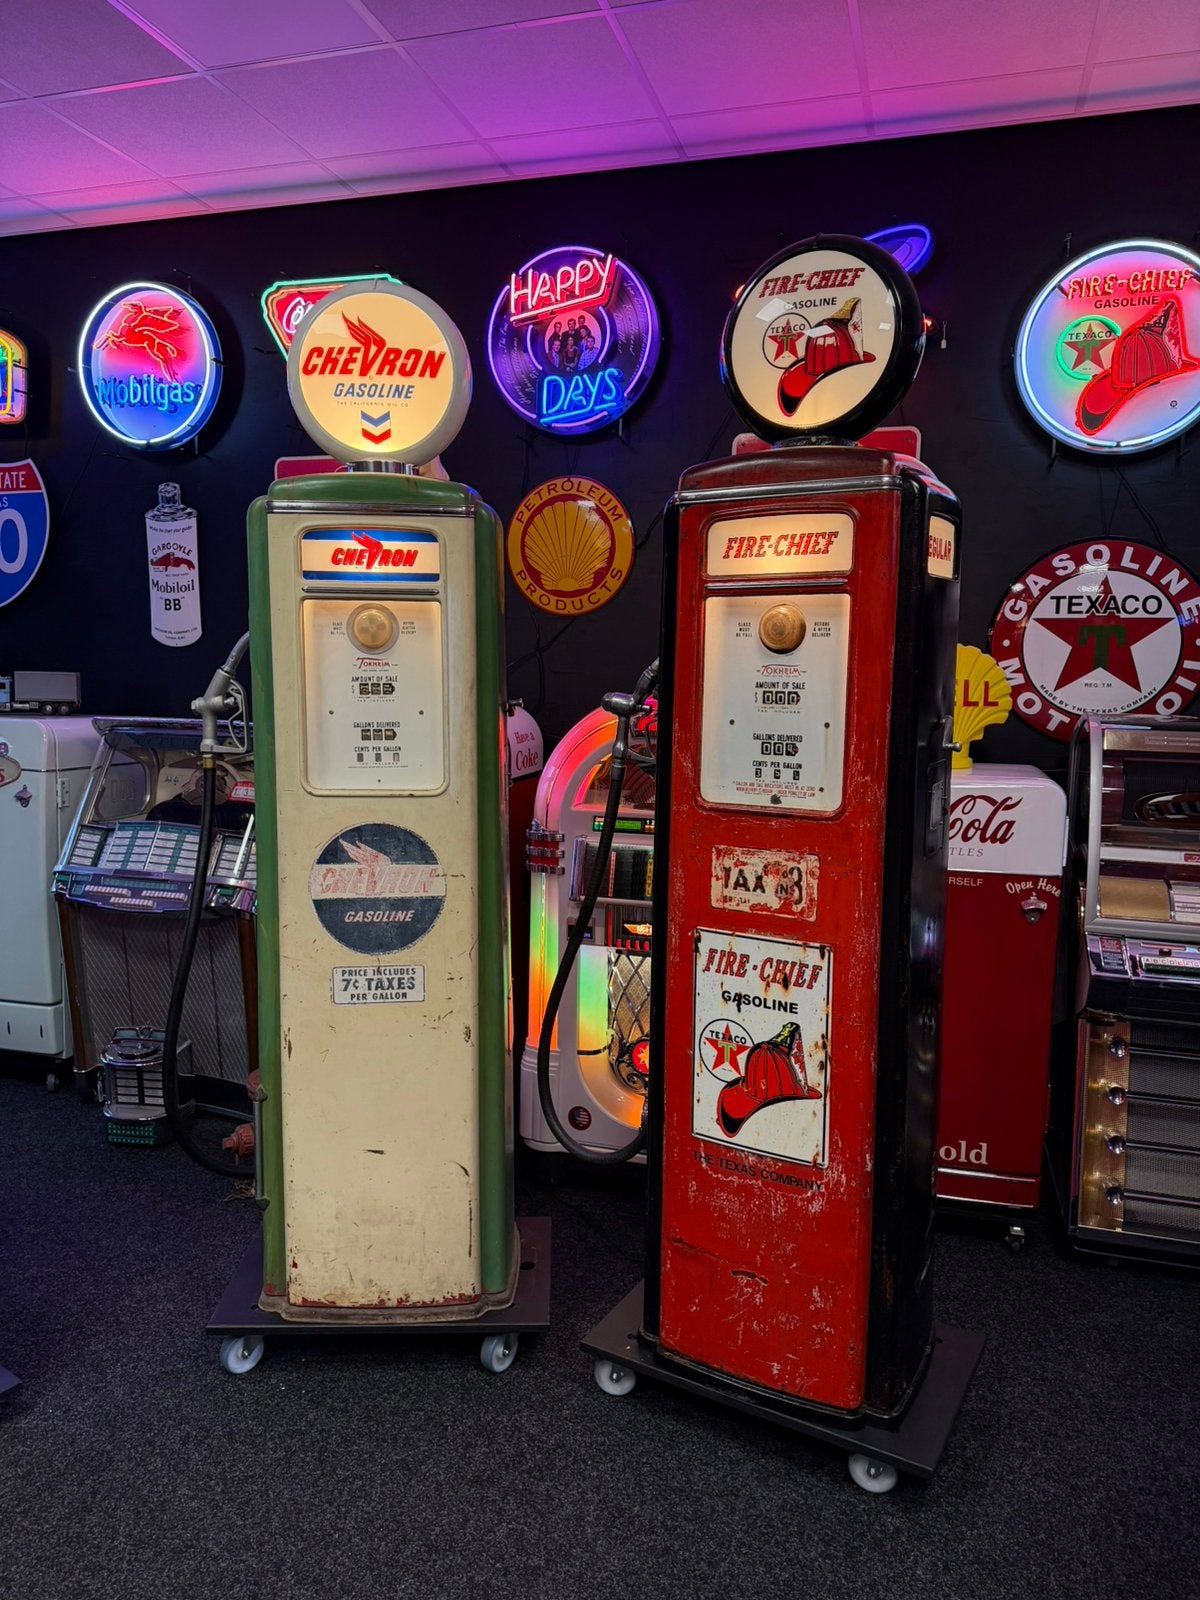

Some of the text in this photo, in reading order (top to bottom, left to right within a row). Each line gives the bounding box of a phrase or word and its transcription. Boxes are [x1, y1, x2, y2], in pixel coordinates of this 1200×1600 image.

[511, 254, 614, 314] HAPPY
[758, 267, 866, 298] FIRE-CHIEF
[1067, 267, 1193, 300] FIRE-CHIEF
[784, 297, 837, 310] GASOLINE
[1093, 295, 1160, 309] GASOLINE
[770, 324, 806, 334] TEXACO
[1068, 330, 1112, 340] TEXACO
[302, 330, 446, 379] CHEVRON
[97, 374, 197, 411] Mobilgas
[334, 383, 415, 399] GASOLINE
[542, 367, 619, 417] DAYS
[516, 480, 623, 524] PETROLEUM
[152, 543, 192, 556] GARGOYLE
[331, 541, 419, 570] CHEVRON
[722, 531, 840, 560] FIRE-CHIEF
[151, 579, 195, 594] Mobiloil
[516, 568, 623, 611] PRODUCTS
[1004, 544, 1200, 622] GASOLINE
[1050, 594, 1163, 615] TEXACO
[761, 664, 801, 676] TOKHEIM
[755, 681, 780, 689] AMOUNT
[1040, 684, 1057, 701] MADE
[1058, 700, 1068, 708] BY
[1071, 705, 1087, 713] THE
[1120, 687, 1158, 711] COMPANY
[514, 731, 535, 744] Have a
[752, 733, 803, 742] GALLONS DELIVERED
[516, 748, 538, 771] Coke
[752, 760, 768, 768] CENTS
[949, 794, 1023, 845] Cola
[1005, 877, 1061, 897] Open Here
[344, 910, 415, 923] GASOLINE
[341, 967, 416, 977] PRICE INCLUDES
[341, 976, 416, 992] 7¢ TAXES
[350, 991, 407, 1001] PER GALLON
[721, 990, 799, 1015] GASOLINE
[709, 1030, 747, 1045] TEXACO
[692, 1151, 824, 1192] THE TEXAS COMPANY
